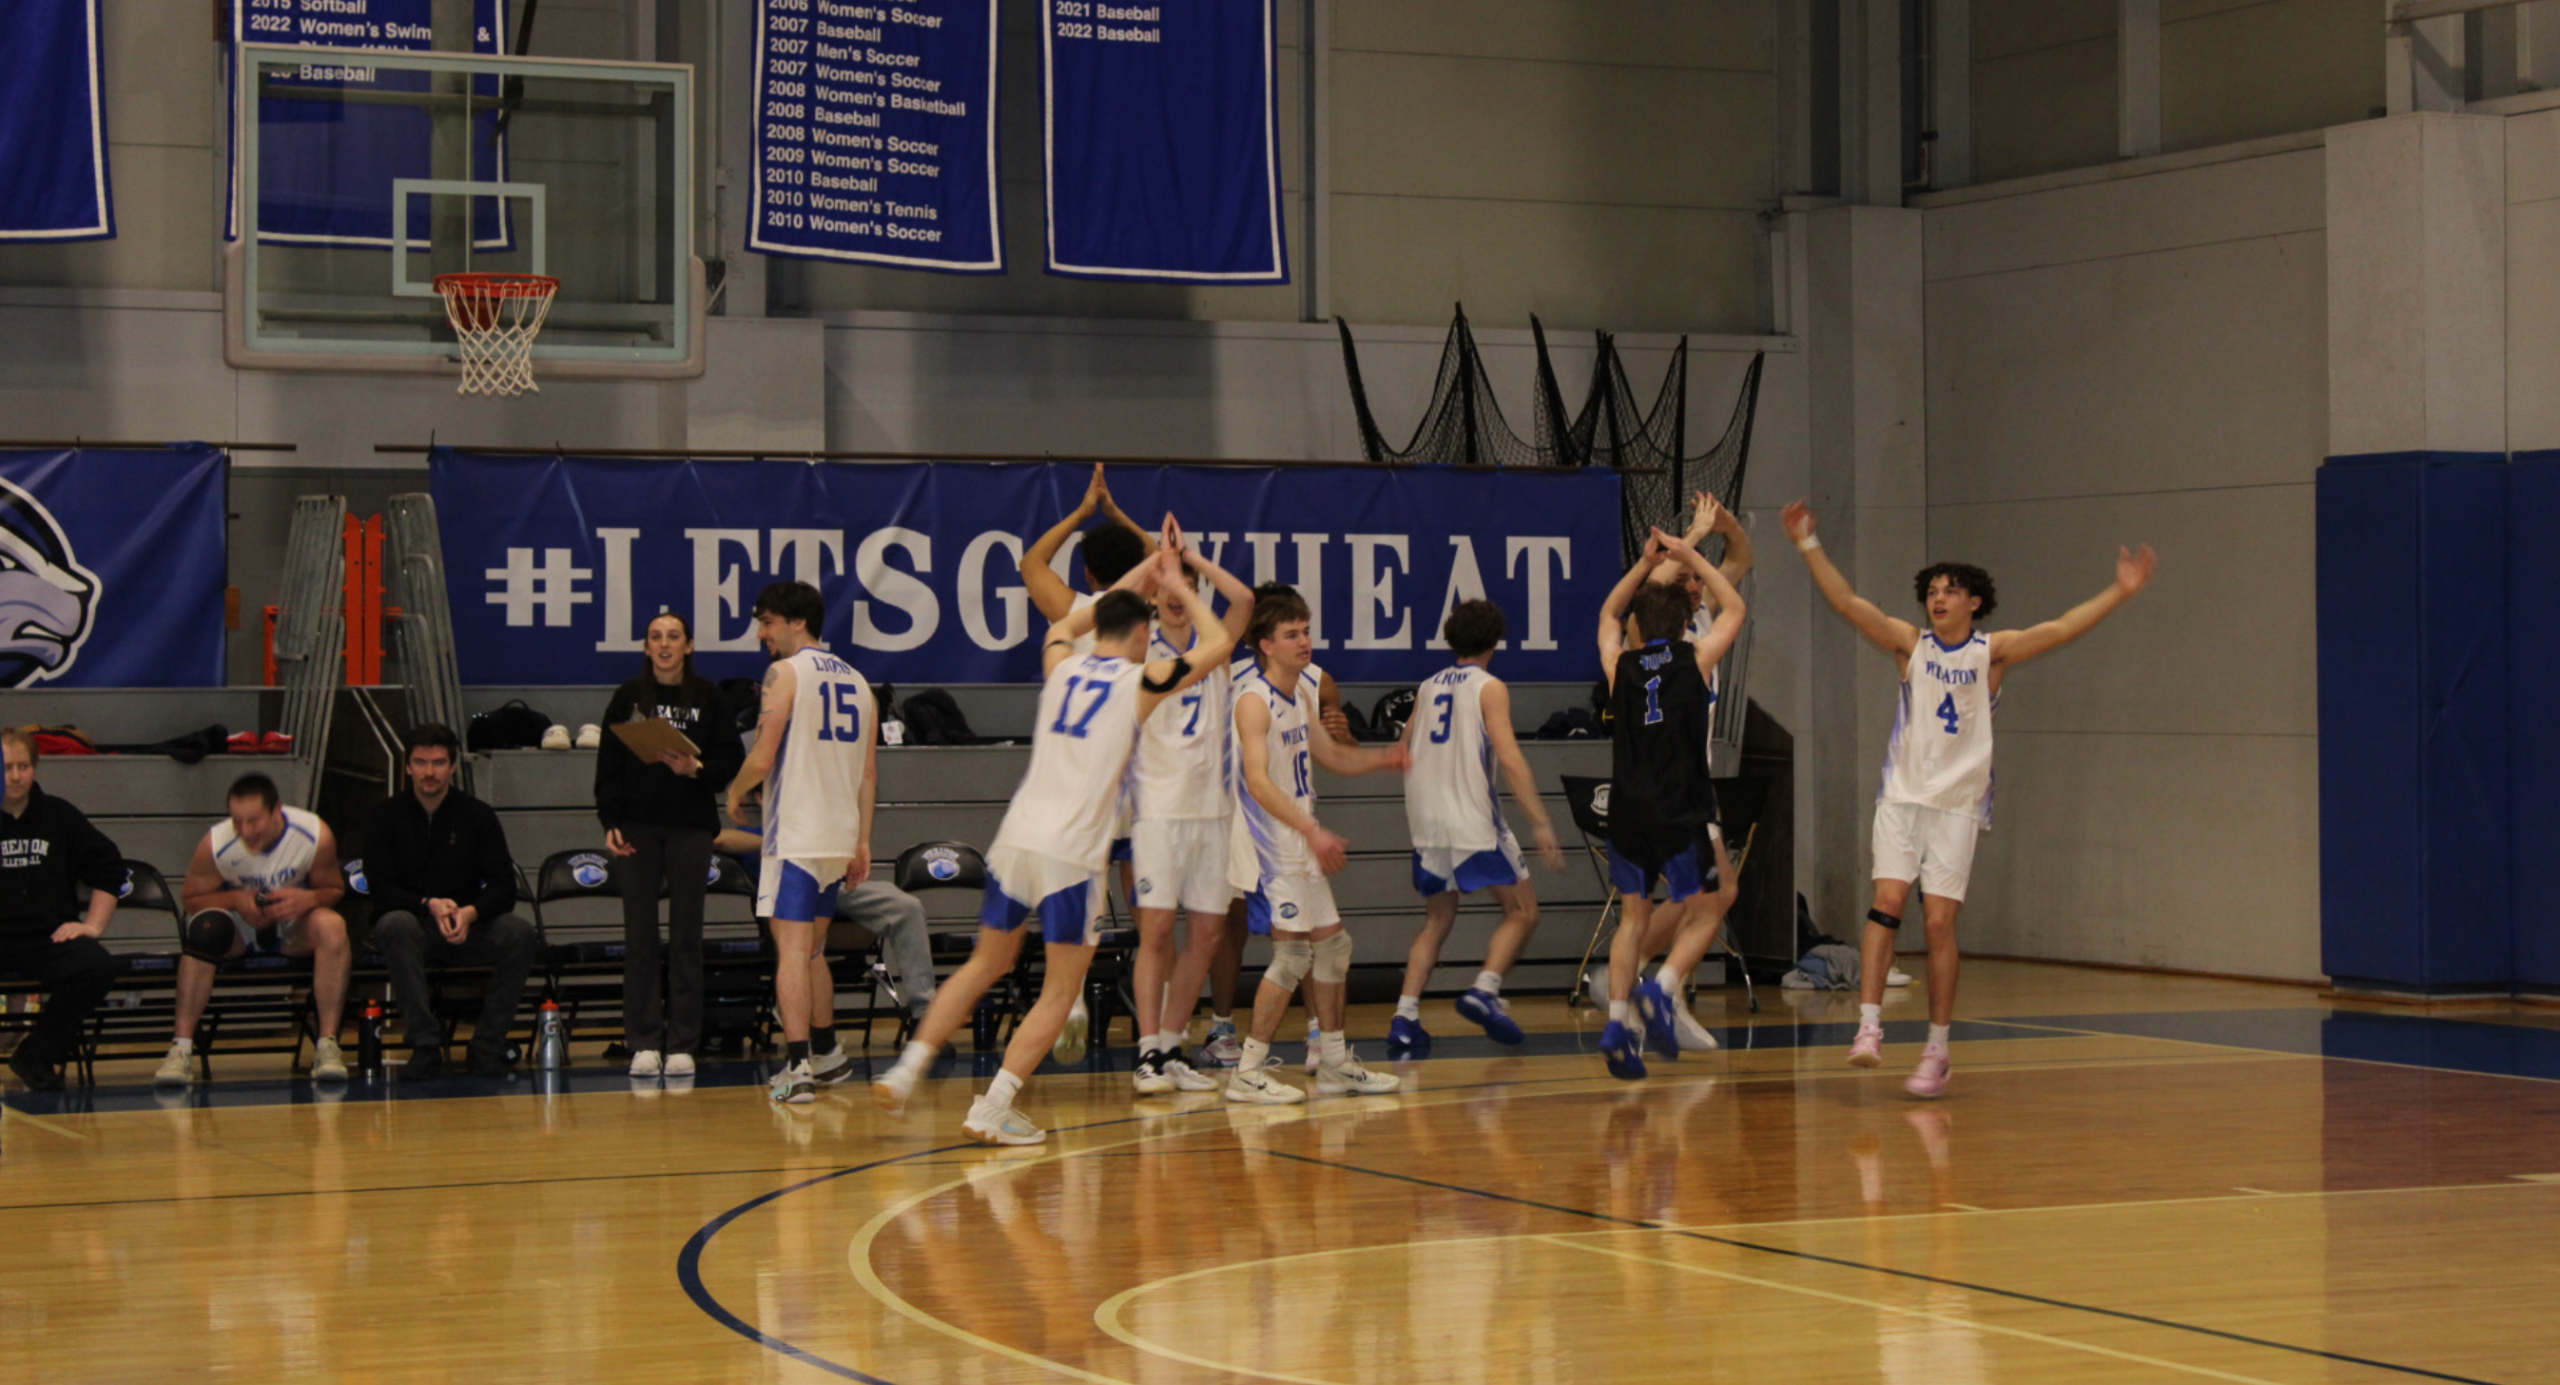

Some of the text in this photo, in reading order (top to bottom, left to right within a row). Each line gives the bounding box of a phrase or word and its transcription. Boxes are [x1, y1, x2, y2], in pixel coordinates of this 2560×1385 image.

[300, 0, 366, 14] Softball
[817, 0, 886, 21] Women's
[891, 8, 942, 28] Soccer
[1056, 1, 1160, 21] 2021 Baseball
[251, 14, 490, 42] 2022 Women's Swim &
[770, 16, 881, 42] 2007 Baseball
[1057, 22, 1160, 42] 2022 Baseball
[770, 38, 920, 67] 2007 Men's Soccer
[300, 64, 376, 82] Baseball
[769, 59, 941, 93] 2007 Women's Soccer
[768, 80, 966, 116] 2008 Women's Basketball
[767, 101, 880, 128] 2008 Baseball
[766, 124, 939, 156] 2008 Women's Soccer
[766, 146, 940, 177] 2009 Women's Soccer
[766, 168, 877, 192] 2010 Baseball
[767, 189, 937, 220] 2010 Women's Tennis
[768, 211, 942, 242] 2010 Women's Soccer
[818, 681, 860, 743] 15
[1050, 675, 1113, 739] 17
[1644, 675, 1663, 725] 1
[1936, 692, 1959, 735] 4
[1182, 696, 1201, 736] 7
[1430, 693, 1453, 744] 3
